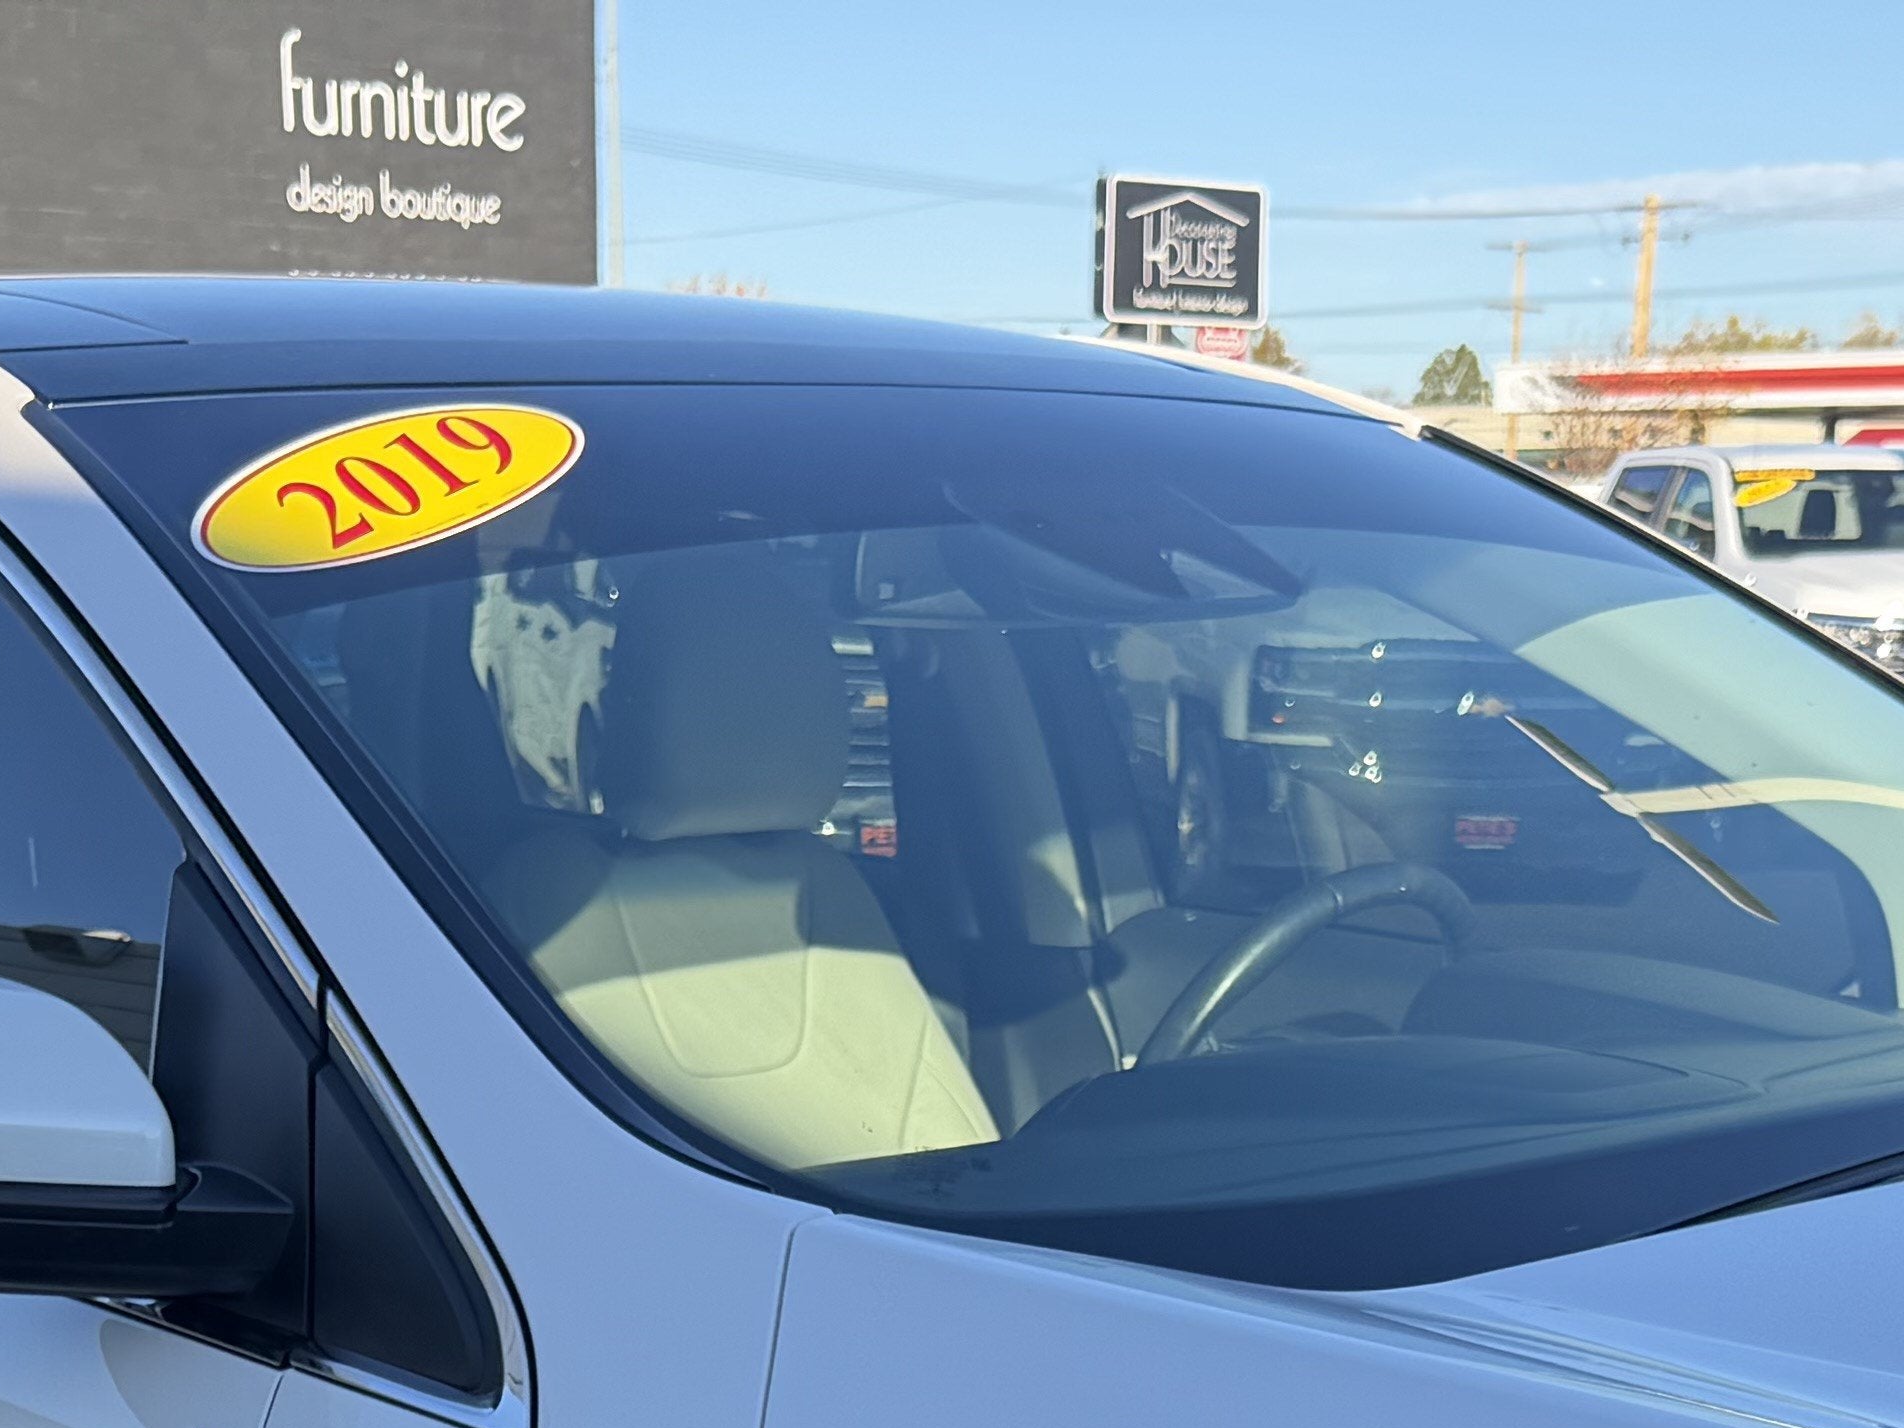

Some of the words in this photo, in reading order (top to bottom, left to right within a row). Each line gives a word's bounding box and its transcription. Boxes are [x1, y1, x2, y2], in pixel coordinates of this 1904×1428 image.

[279, 27, 527, 152] furniture
[286, 161, 375, 223] design
[379, 168, 503, 230] boutique
[276, 416, 513, 551] 2019
